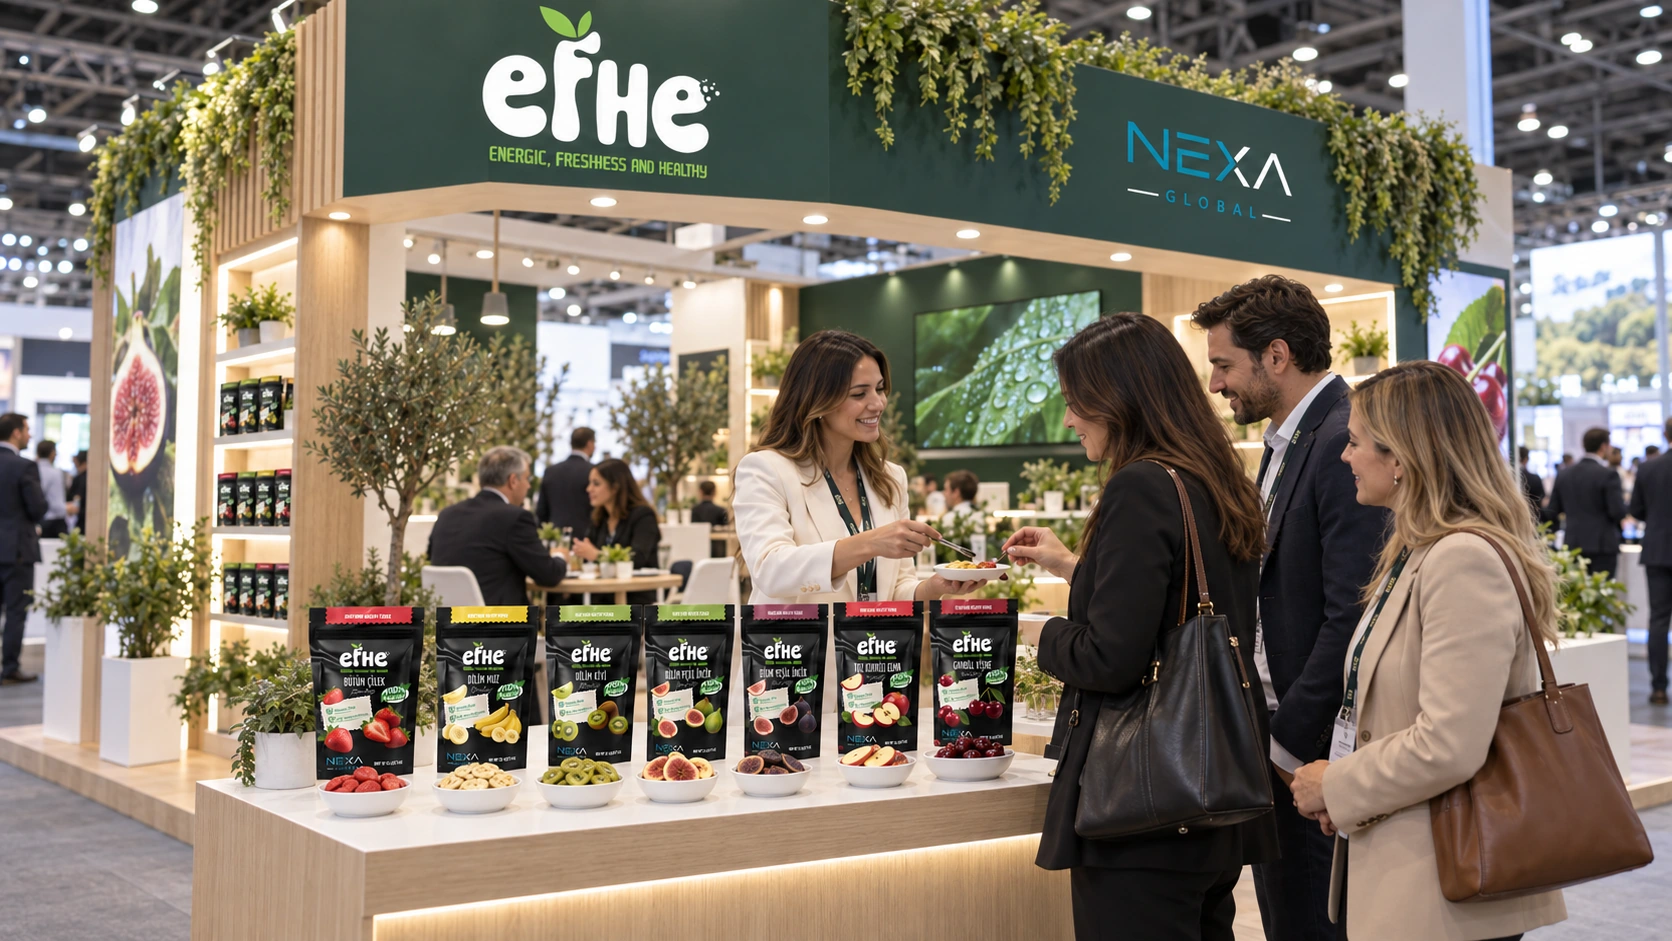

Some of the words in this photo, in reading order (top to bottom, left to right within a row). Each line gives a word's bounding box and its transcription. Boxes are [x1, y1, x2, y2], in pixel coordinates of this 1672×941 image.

[489, 145, 551, 168] ENERGIC,
[631, 158, 655, 174] AND
[659, 161, 708, 179] HEALTHY
[1127, 120, 1293, 197] NEXA
[1165, 189, 1257, 219] GLOBAL
